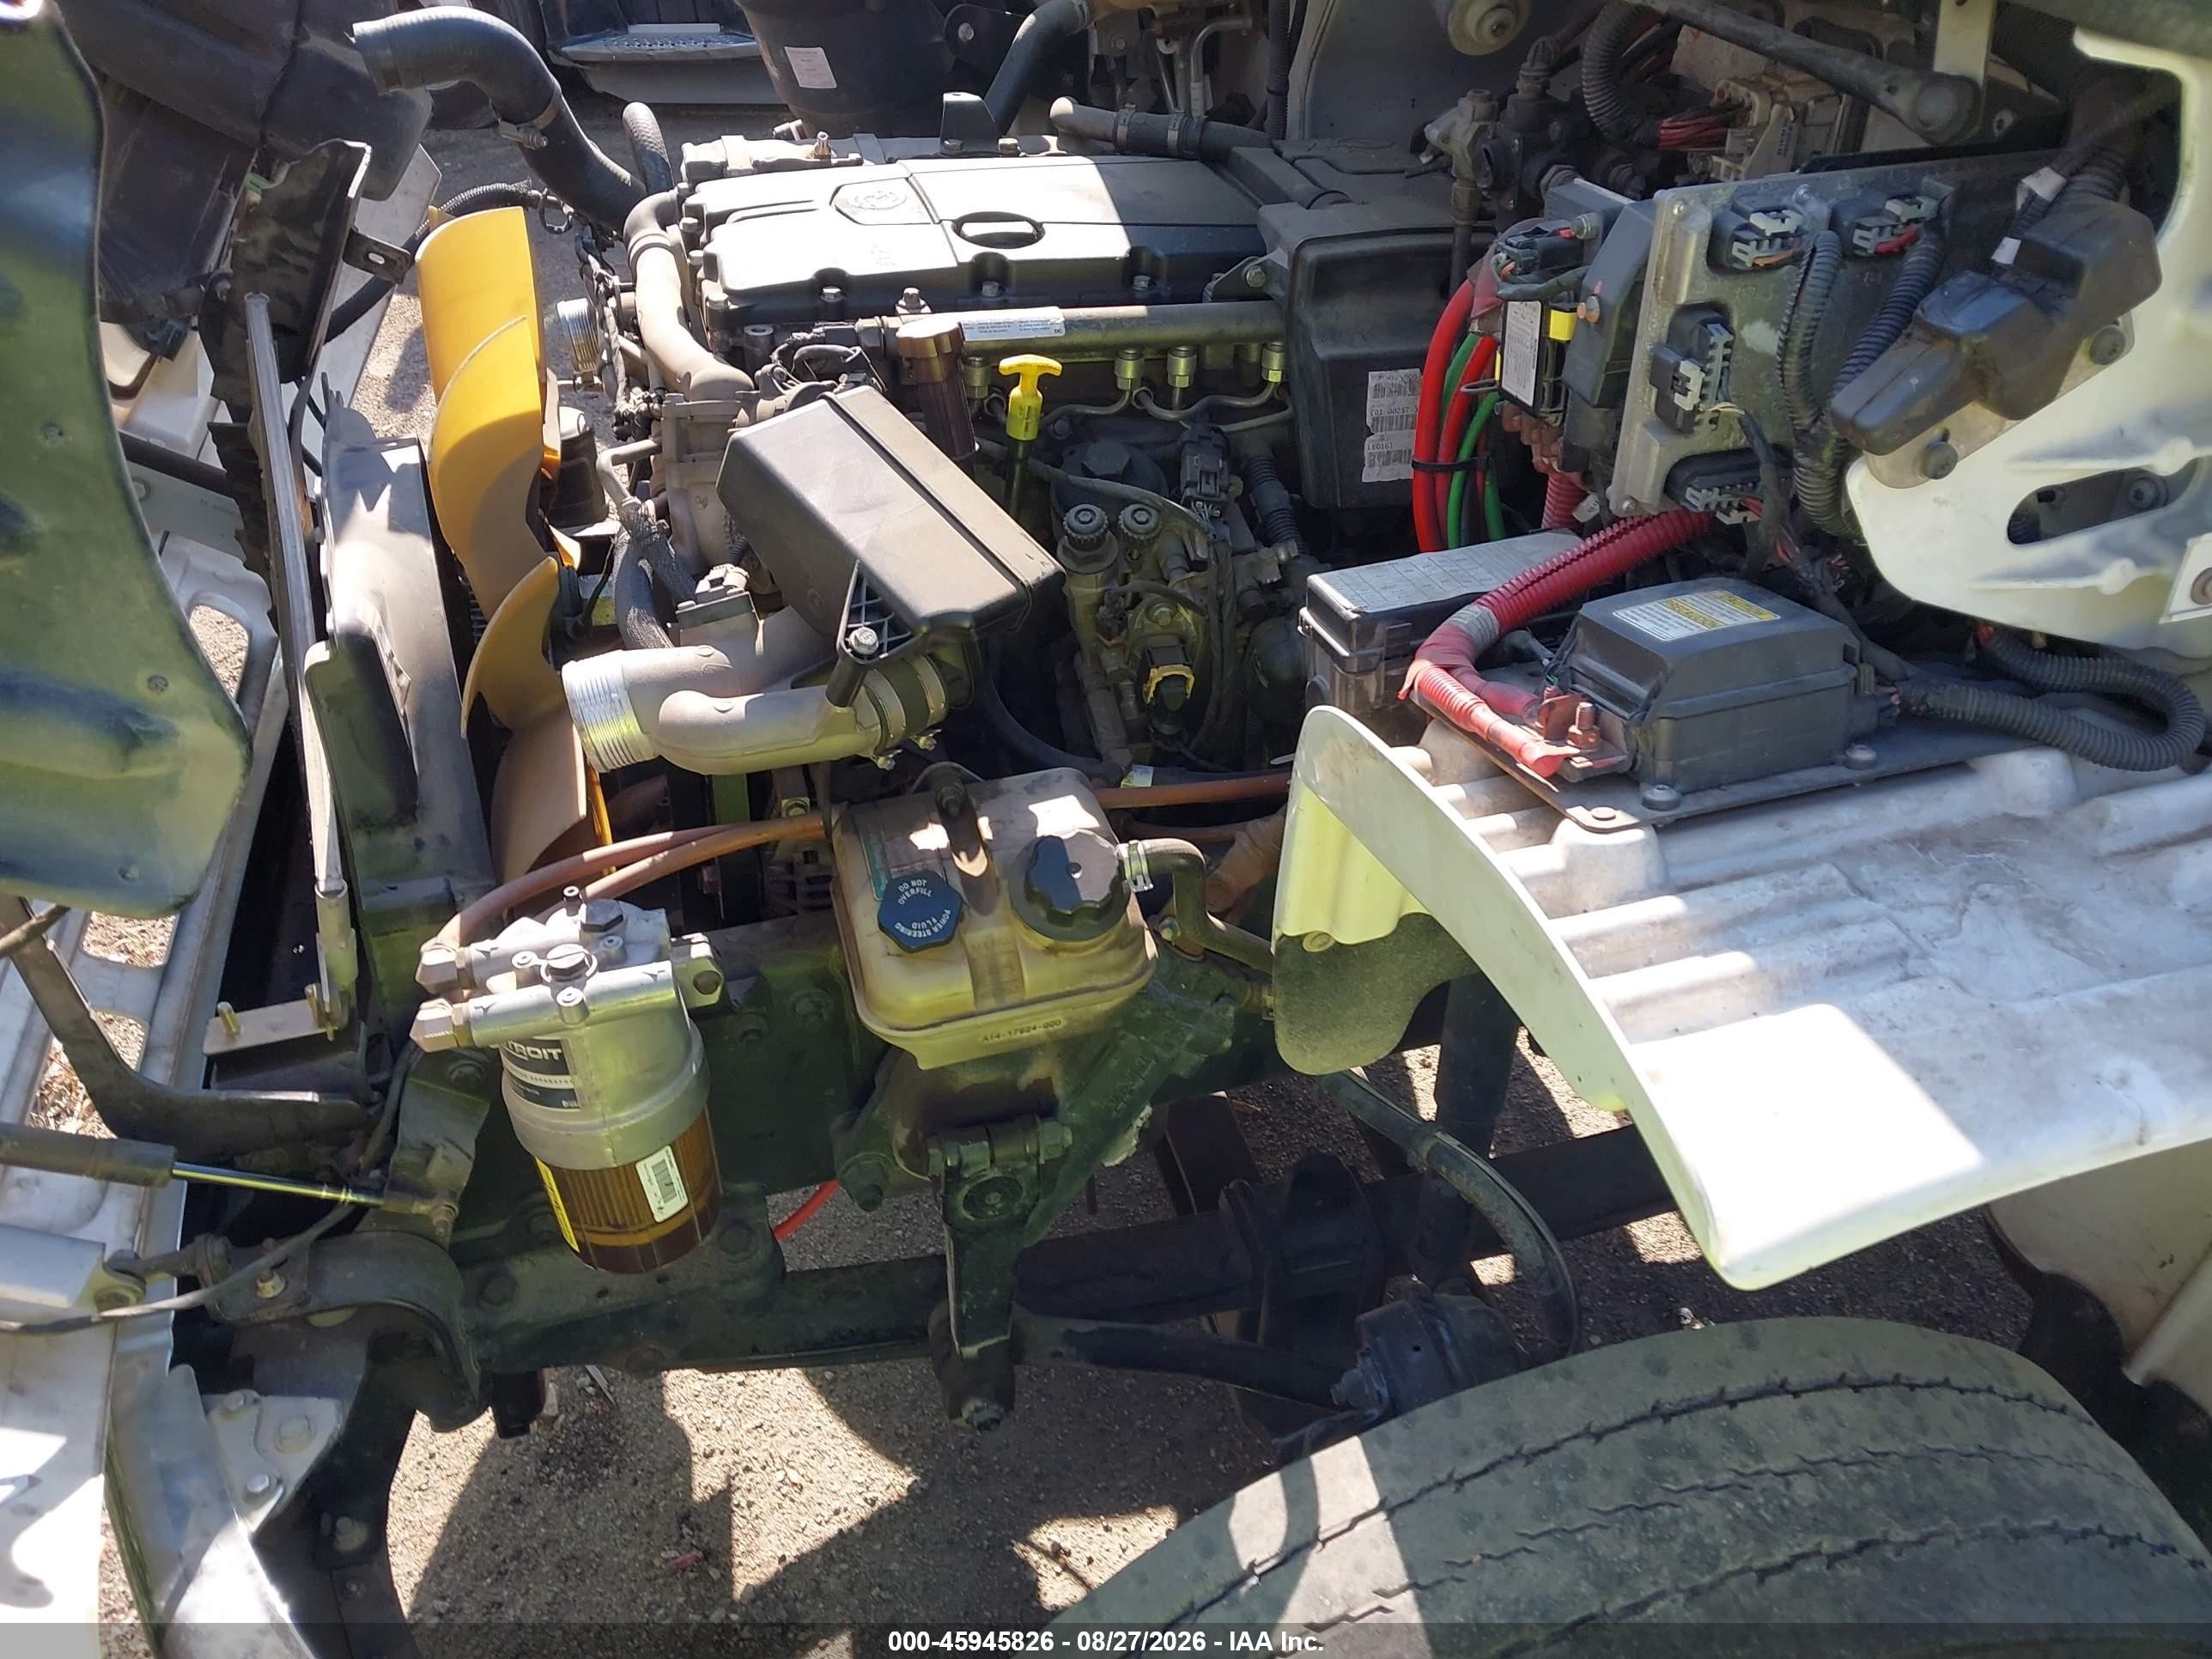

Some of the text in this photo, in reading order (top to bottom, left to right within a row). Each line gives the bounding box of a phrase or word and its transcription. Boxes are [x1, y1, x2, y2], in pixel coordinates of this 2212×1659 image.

[898, 878, 927, 893] DO NOT
[897, 887, 933, 905] OVERFILL
[894, 908, 951, 939] POWER STEERING
[911, 915, 938, 930] FLUID
[504, 1040, 562, 1060] TROIT
